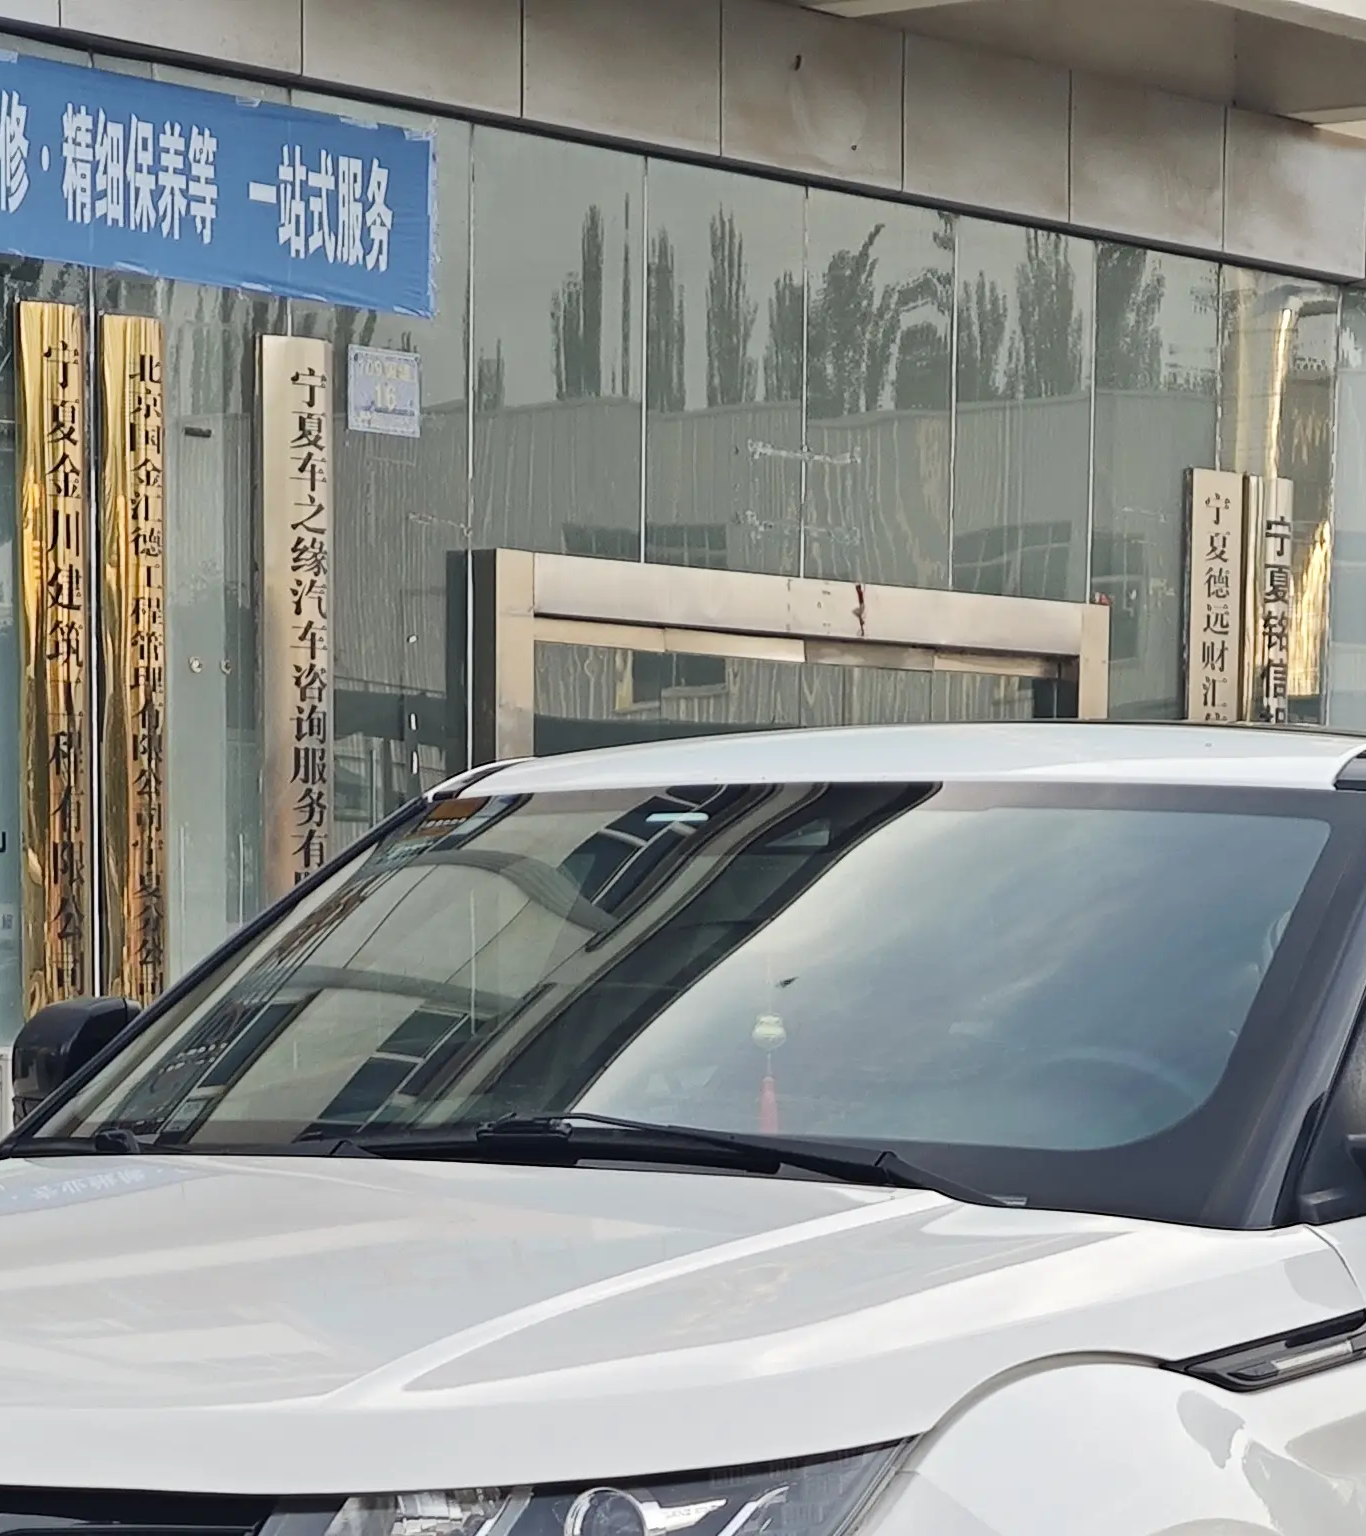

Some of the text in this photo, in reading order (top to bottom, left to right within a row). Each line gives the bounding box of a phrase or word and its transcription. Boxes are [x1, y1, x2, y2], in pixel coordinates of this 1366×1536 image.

[246, 146, 394, 275] 一站式服务
[290, 366, 328, 886] 宁夏车之缘汽车咨询服务有
[1201, 492, 1232, 722] 宁夏德远财汇
